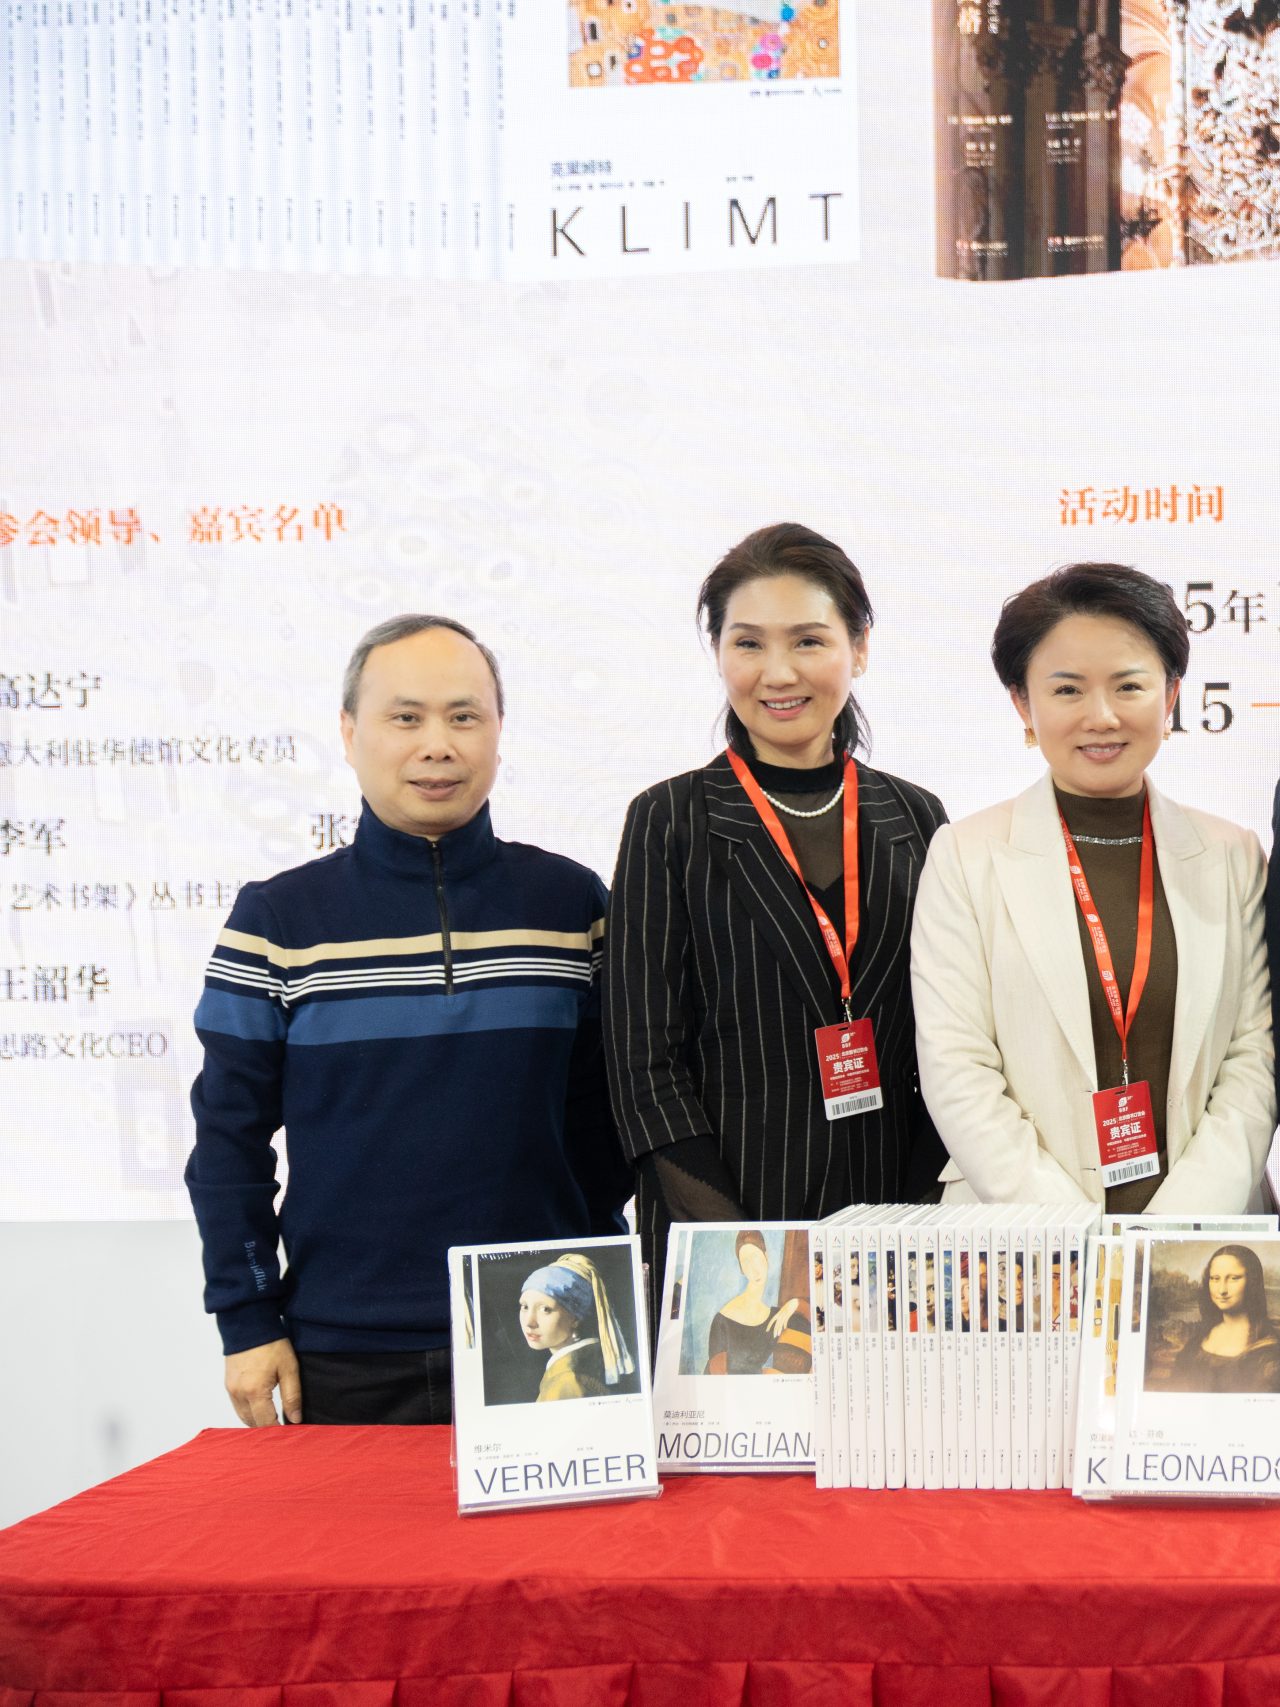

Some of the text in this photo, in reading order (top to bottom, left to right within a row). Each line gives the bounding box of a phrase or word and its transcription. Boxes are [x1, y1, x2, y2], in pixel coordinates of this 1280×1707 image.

[550, 193, 843, 257] KLIMT
[1058, 484, 1225, 526] 活动时间
[0, 879, 243, 912] 艺术书架》丛书主
[825, 1053, 840, 1062] 2025
[833, 1057, 864, 1074] 贵宾证
[1102, 1117, 1117, 1127] 2025
[1109, 1121, 1141, 1140] 贵宾证
[657, 1431, 815, 1459] MODIGLIAN
[474, 1453, 647, 1495] VERMEER
